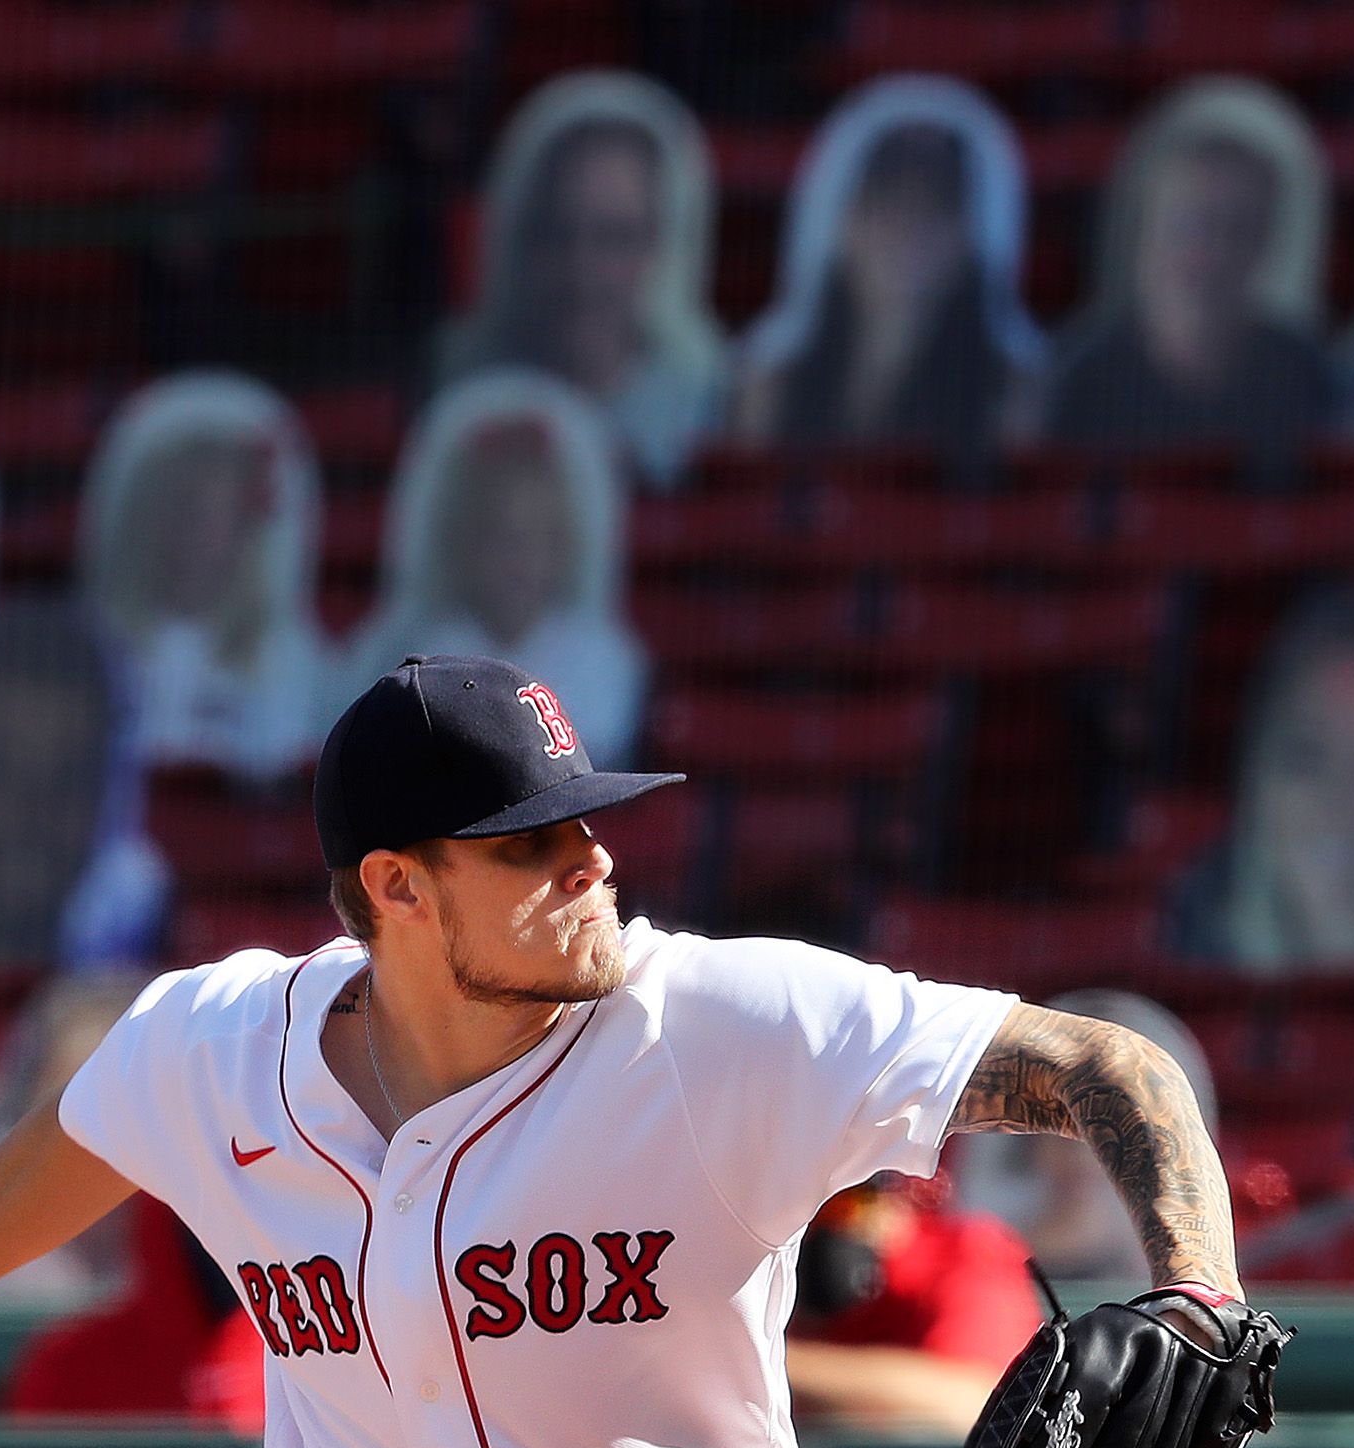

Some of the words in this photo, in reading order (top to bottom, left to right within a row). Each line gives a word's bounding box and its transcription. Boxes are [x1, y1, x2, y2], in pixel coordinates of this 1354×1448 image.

[515, 681, 577, 760] B
[236, 1254, 362, 1359] RED
[454, 1229, 676, 1343] SOX
